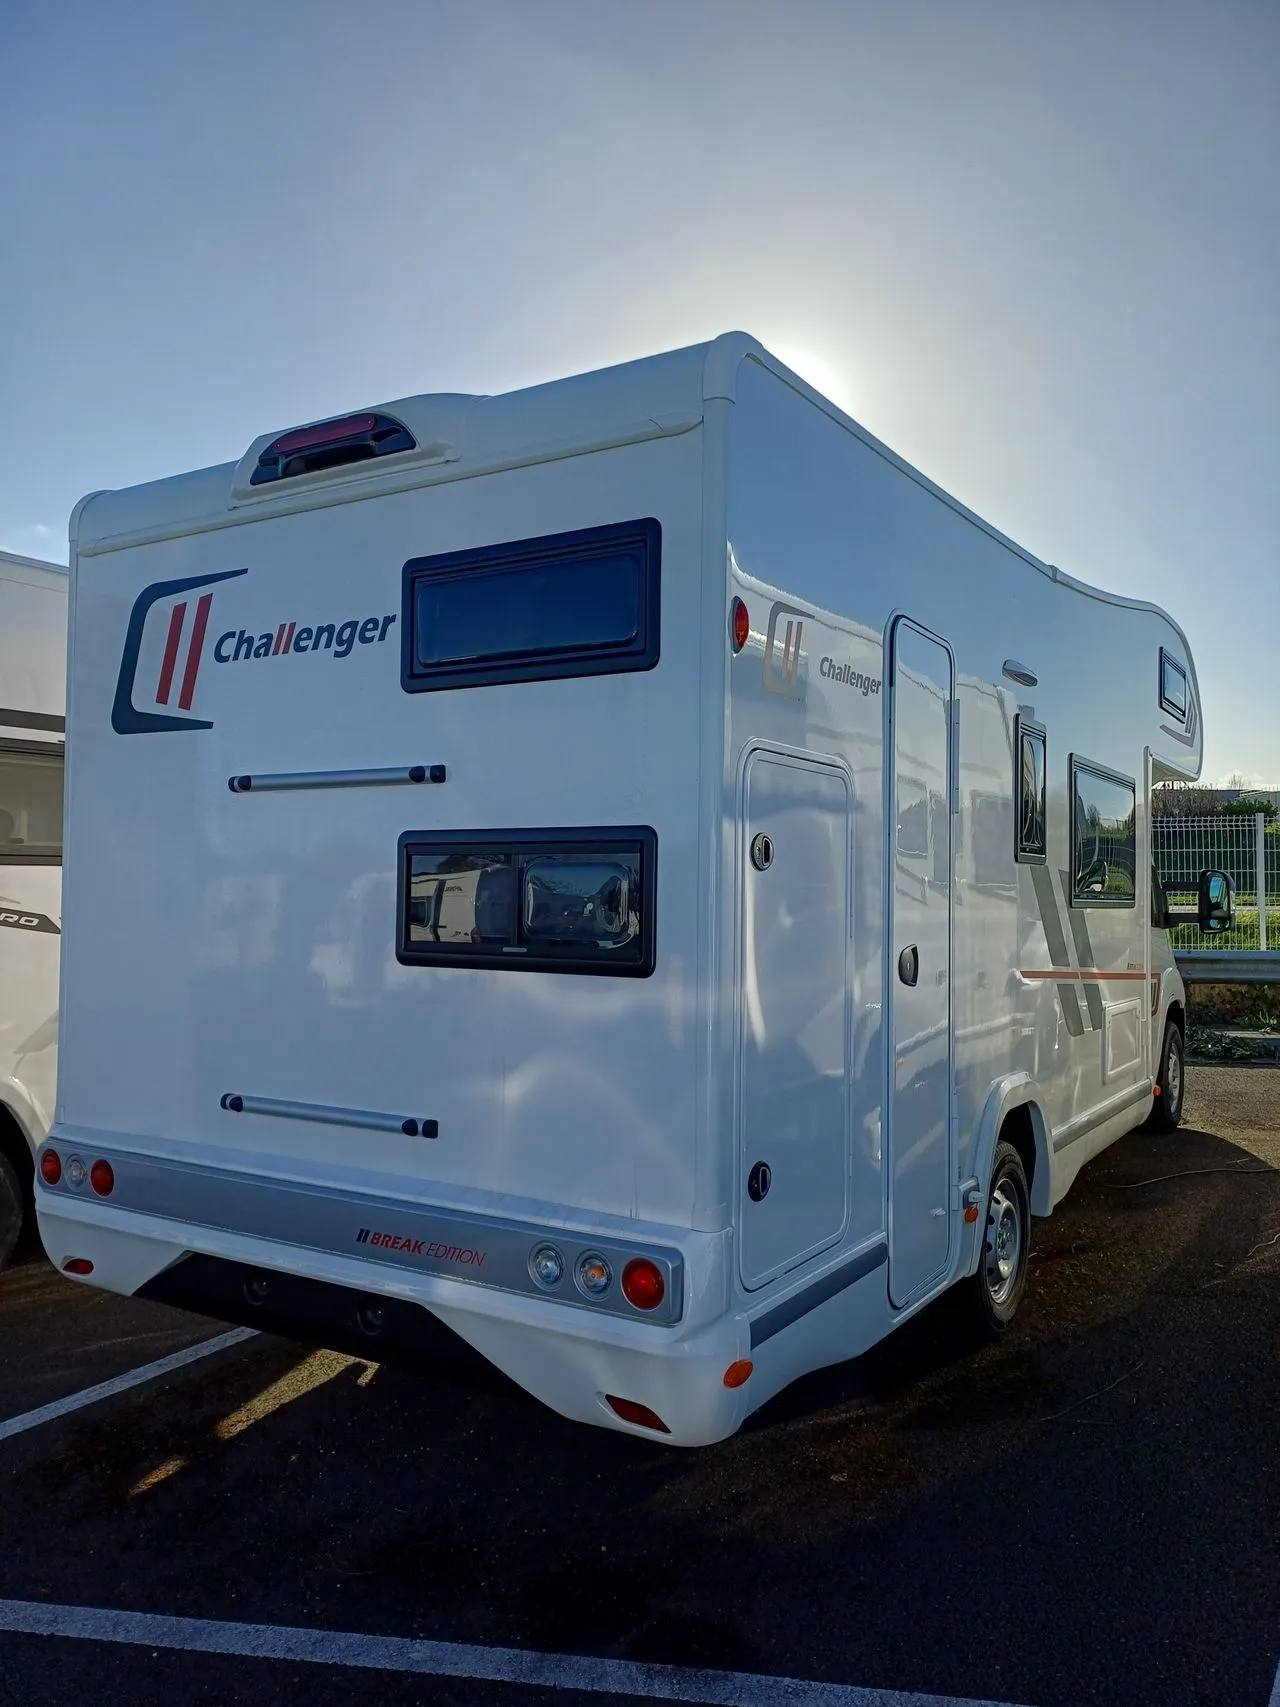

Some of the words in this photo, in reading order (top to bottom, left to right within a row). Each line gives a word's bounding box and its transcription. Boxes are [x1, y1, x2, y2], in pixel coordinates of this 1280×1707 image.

[213, 614, 397, 663] Challenger
[820, 656, 881, 697] Challenger
[369, 1231, 426, 1255] BREAK
[426, 1242, 487, 1266] EDITION
